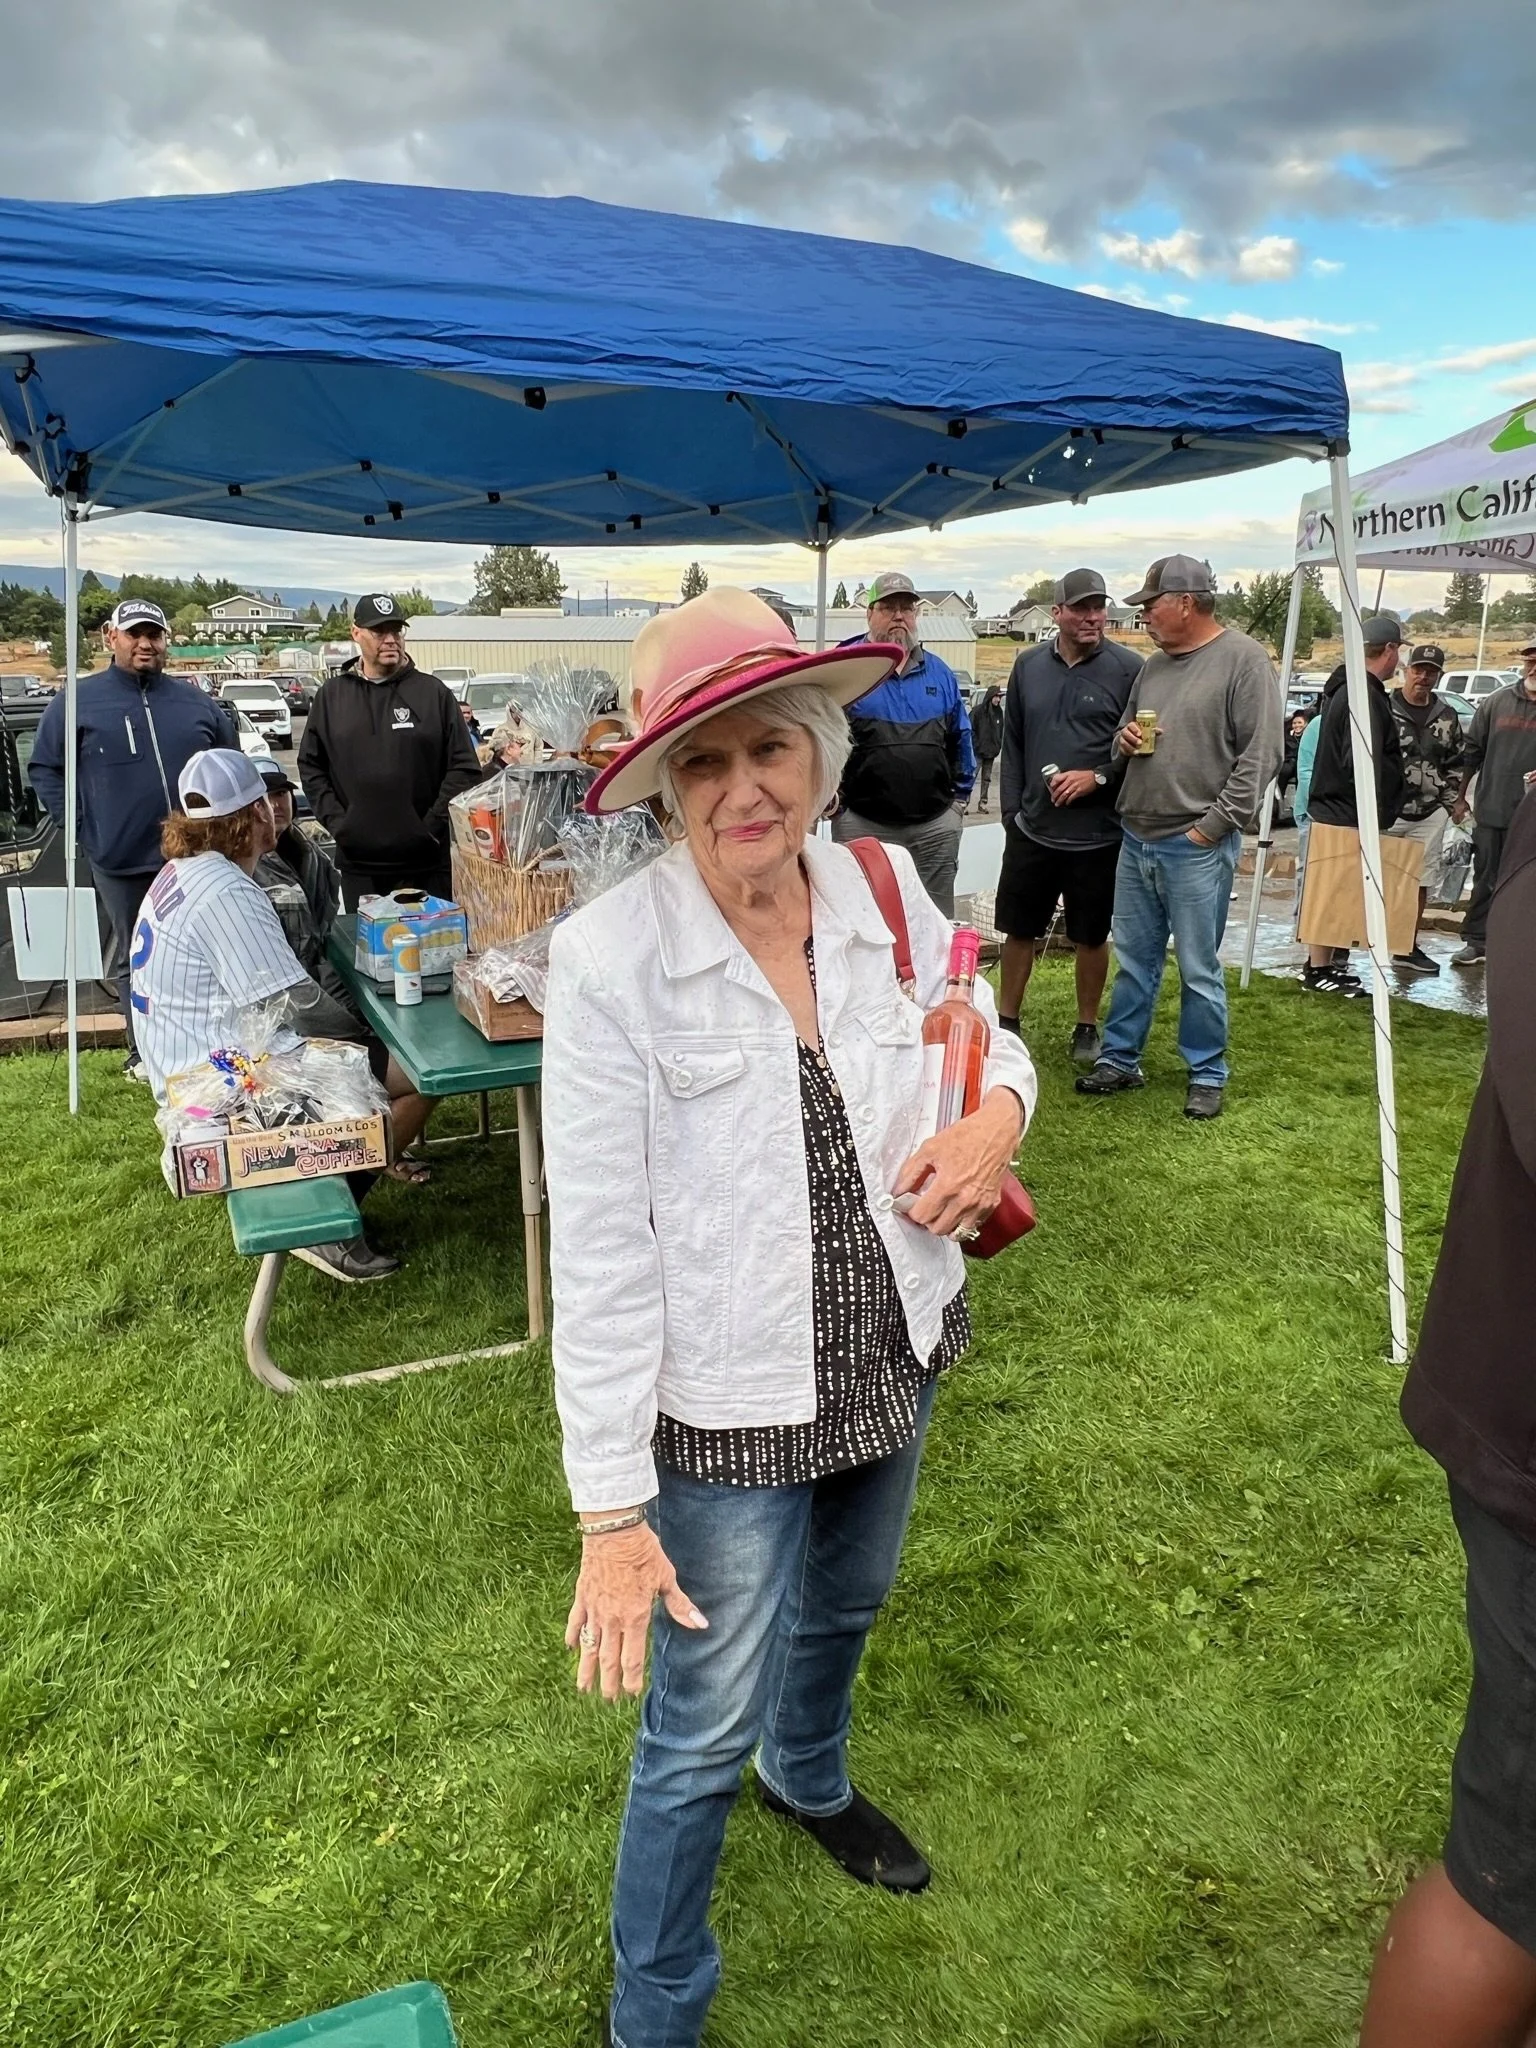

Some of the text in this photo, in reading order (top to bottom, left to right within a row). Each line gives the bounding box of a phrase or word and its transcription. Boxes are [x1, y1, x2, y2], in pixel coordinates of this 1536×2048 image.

[1319, 473, 1536, 545] Nrthern Calif
[240, 1145, 289, 1178] NEW
